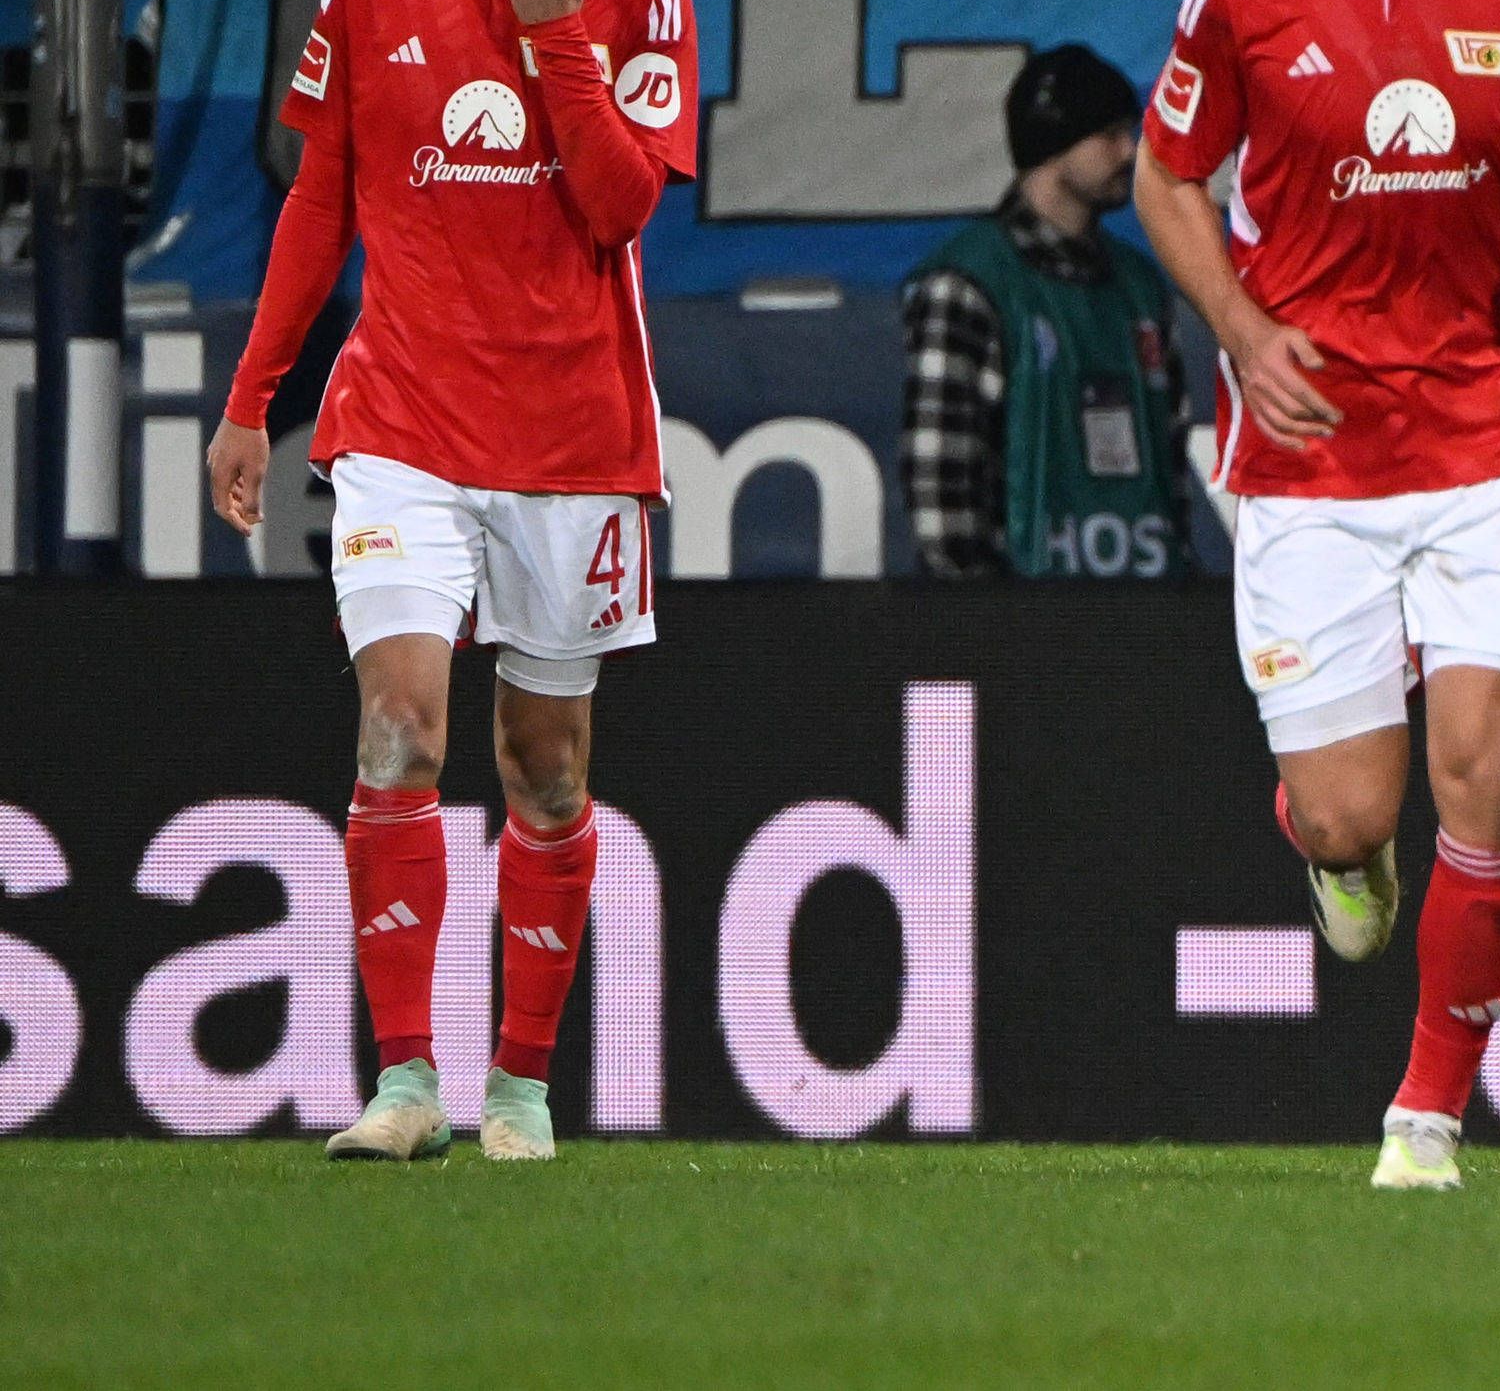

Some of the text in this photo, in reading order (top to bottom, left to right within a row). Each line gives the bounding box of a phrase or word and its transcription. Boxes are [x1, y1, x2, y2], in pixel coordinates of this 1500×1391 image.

[623, 71, 673, 109] JD
[410, 144, 565, 188] Paramount+
[1329, 155, 1490, 202] Paramount+
[585, 512, 625, 595] 4
